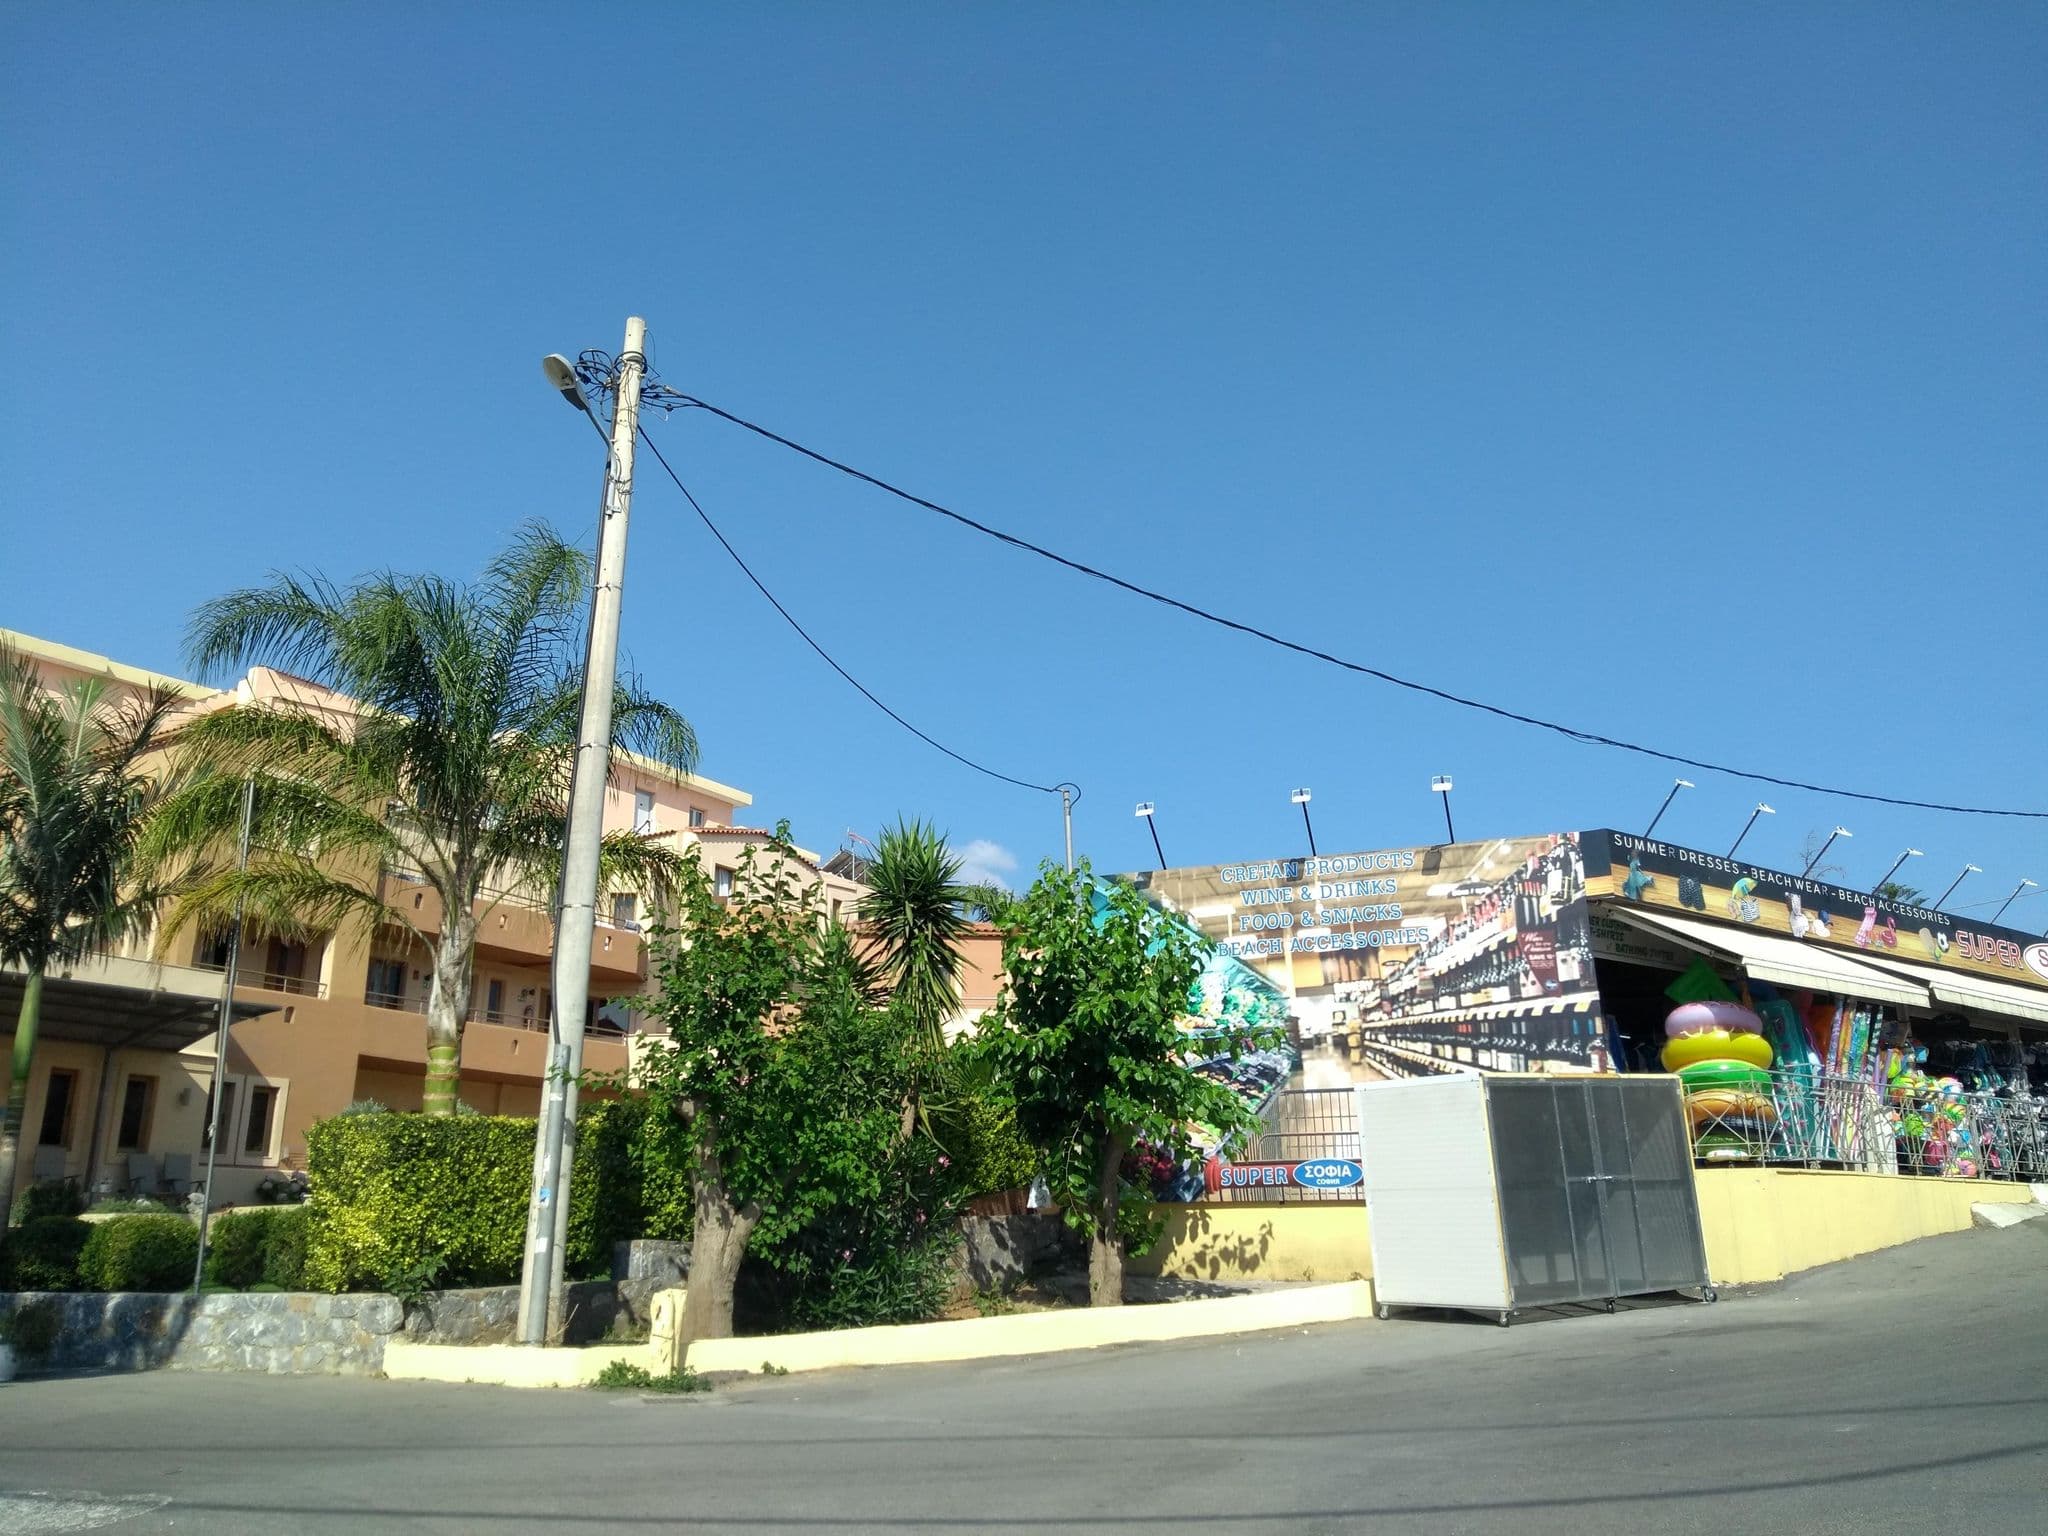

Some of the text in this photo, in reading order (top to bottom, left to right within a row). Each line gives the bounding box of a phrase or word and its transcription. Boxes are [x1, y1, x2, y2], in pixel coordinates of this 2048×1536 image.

[1221, 851, 1415, 884] CRETAN PRODUCTS
[1614, 833, 1677, 858] SUMMER
[1679, 849, 1740, 874] DRESSES
[1751, 867, 1792, 888] BEACH
[1794, 878, 1829, 897] WEAR
[1839, 889, 1876, 908] BEACH
[1878, 902, 1951, 927] ACCESSORIES
[1240, 878, 1398, 906] WINE & DRINKS
[1240, 903, 1403, 932] FOOD & SNACKS
[1217, 928, 1431, 957] BEACH ACCESSORIES
[1955, 930, 2024, 969] SUPER
[1220, 1167, 1289, 1186] SUPER
[1304, 1164, 1352, 1178] ΣΟΦΙΑ
